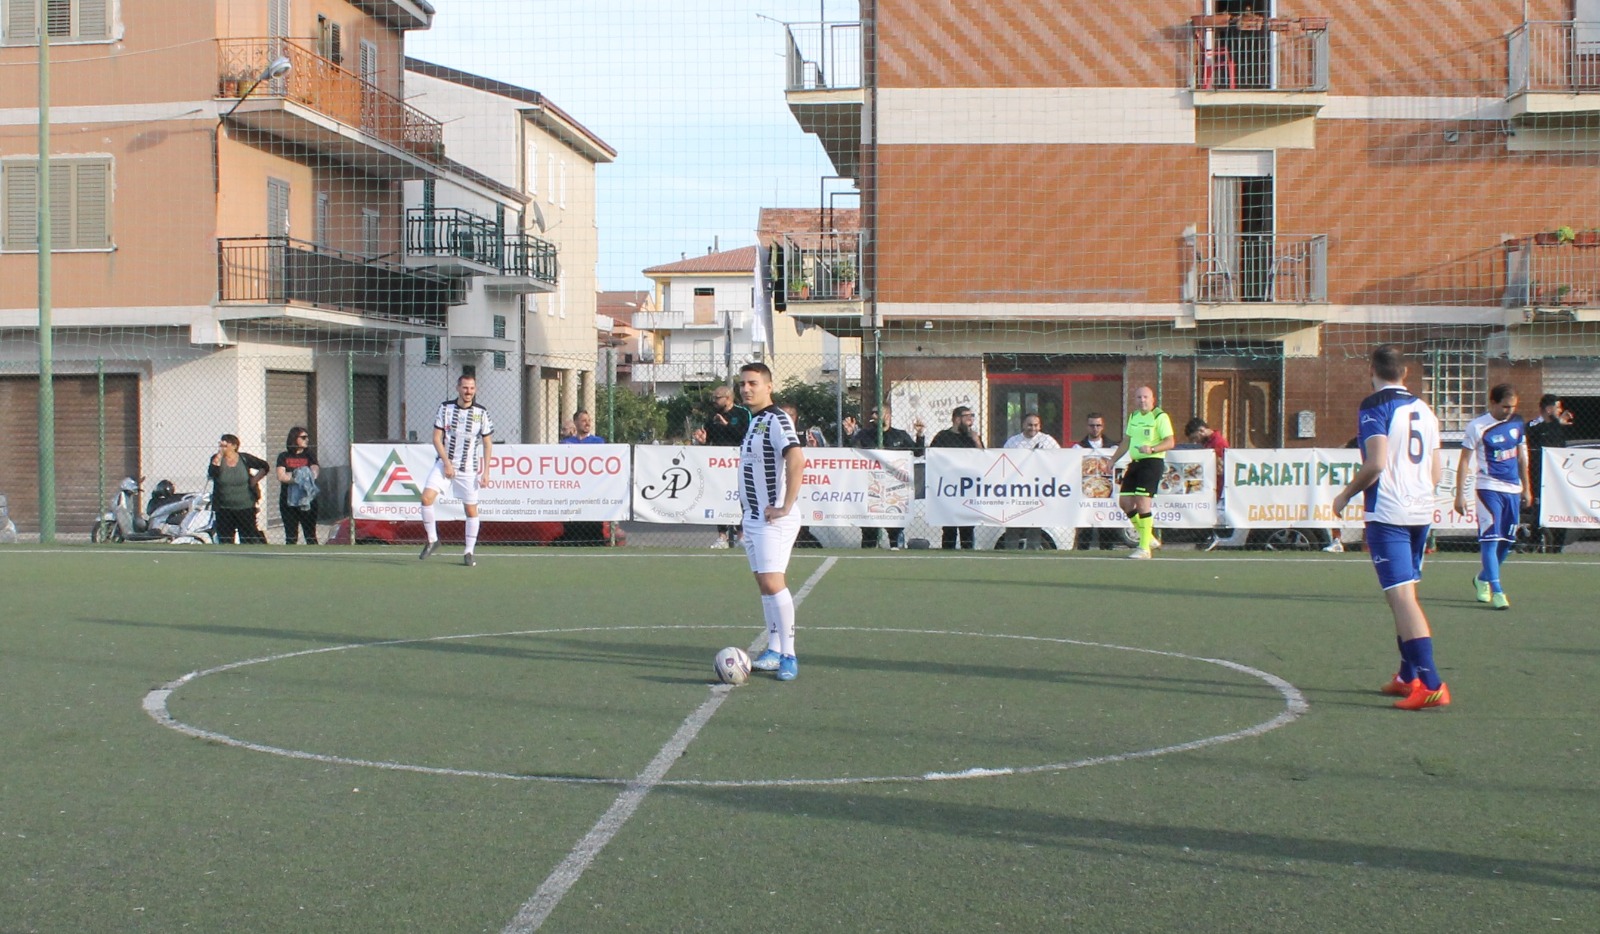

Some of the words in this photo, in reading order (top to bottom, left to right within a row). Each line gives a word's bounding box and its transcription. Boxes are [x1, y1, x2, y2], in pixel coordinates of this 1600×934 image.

[1408, 411, 1423, 464] 6
[477, 456, 532, 475] UPPO
[540, 456, 621, 475] FUOCO
[804, 459, 882, 470] AFFETTERIA
[801, 474, 831, 485] ERIA
[1234, 462, 1310, 486] CARIATI
[1317, 462, 1363, 486] PETR
[549, 480, 581, 489] TERRA
[725, 490, 741, 501] 35
[811, 491, 865, 503] CARIATI
[360, 506, 397, 515] GRUPPO
[1248, 504, 1309, 521] GASOLIO
[1549, 515, 1571, 523] ZONA
